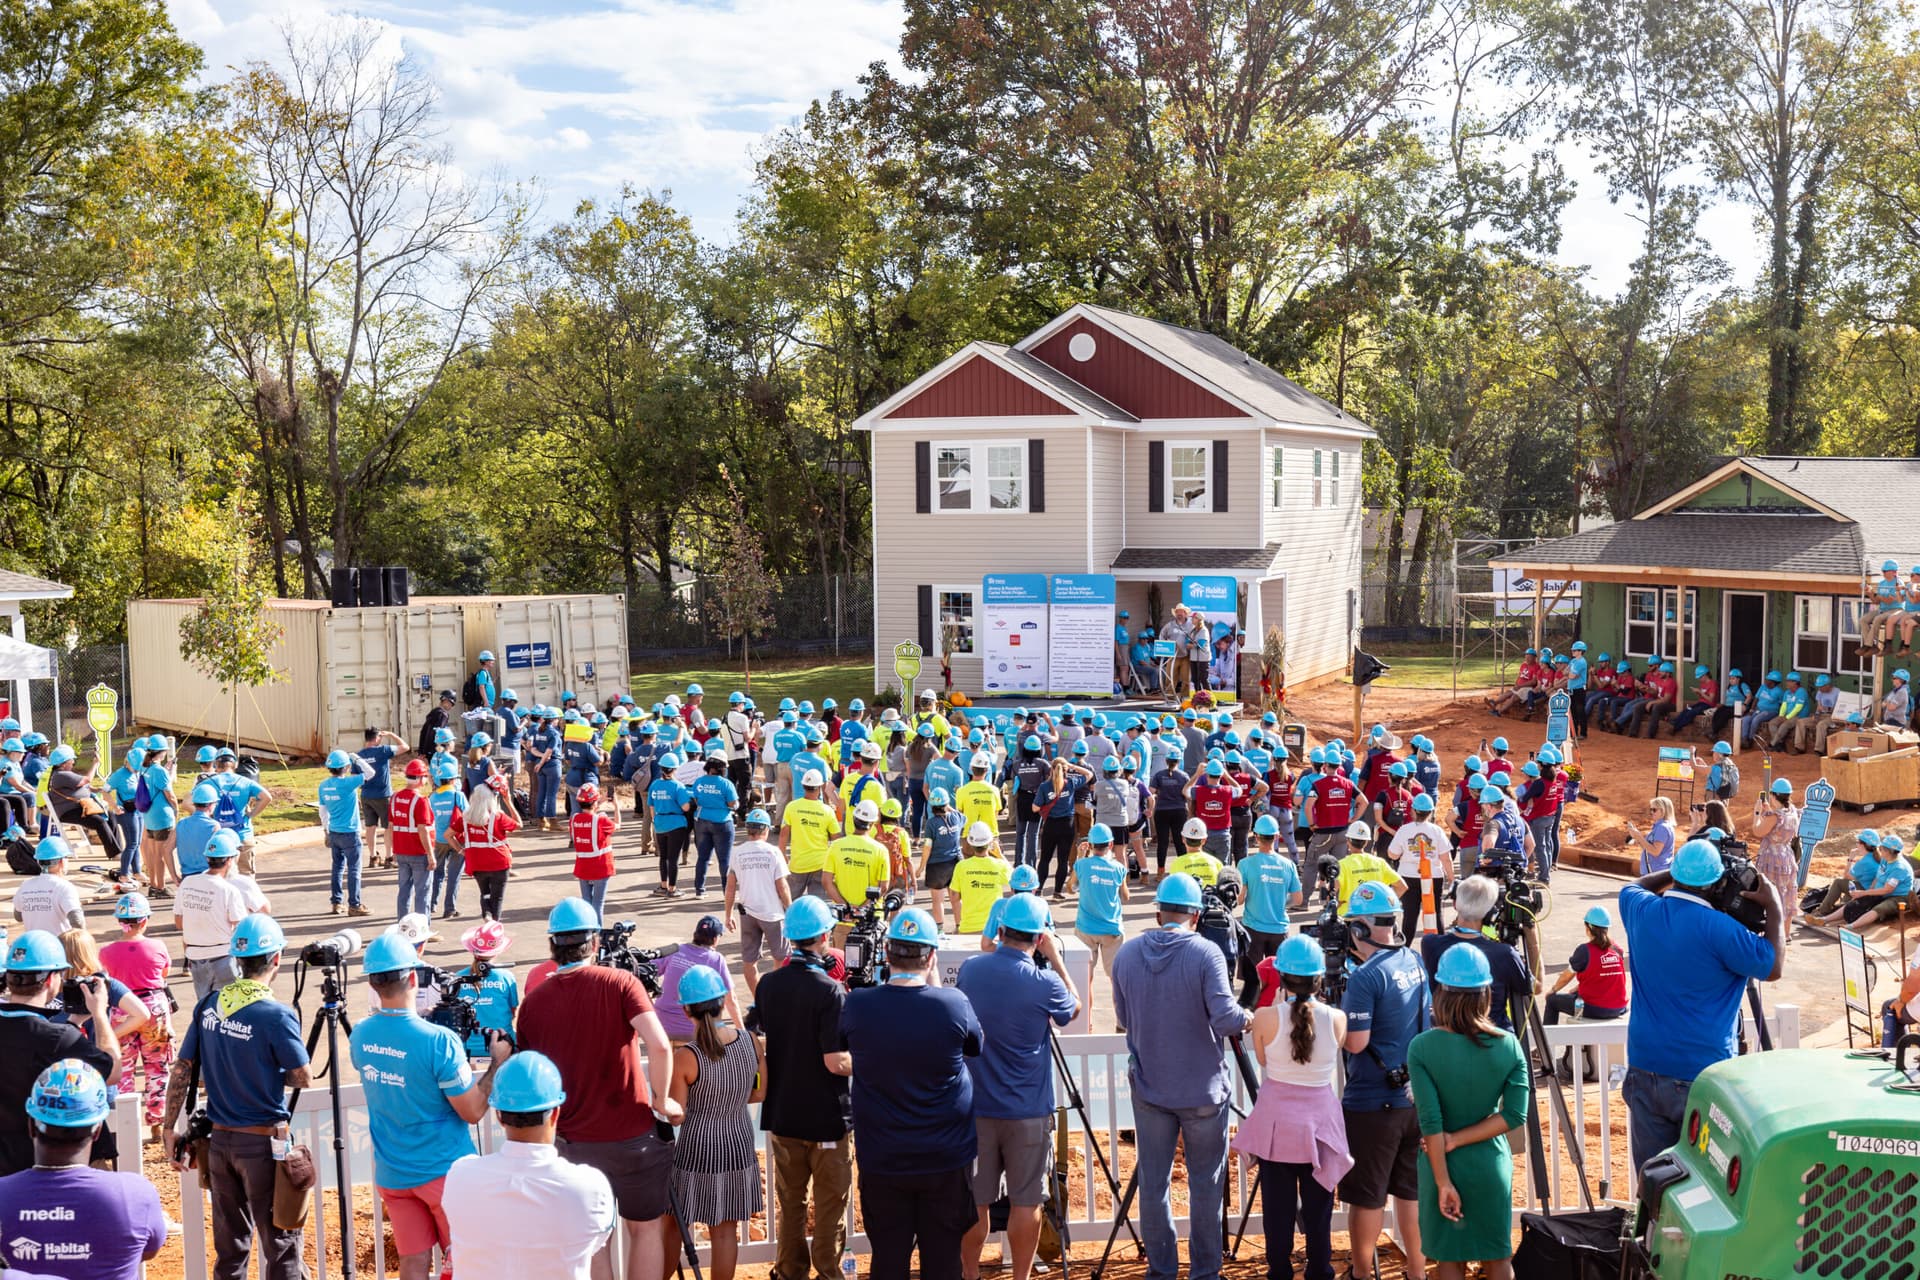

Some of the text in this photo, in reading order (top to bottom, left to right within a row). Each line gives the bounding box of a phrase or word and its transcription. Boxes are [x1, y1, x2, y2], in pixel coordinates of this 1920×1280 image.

[1542, 582, 1576, 591] Habiat
[947, 967, 961, 975] OU
[460, 980, 503, 990] oluteer
[220, 1018, 252, 1034] Habitat
[362, 1043, 407, 1059] volunteer
[380, 1071, 405, 1083] Habitat
[1840, 1136, 1918, 1156] 1040969
[19, 1206, 75, 1221] media
[44, 1243, 90, 1254] Habitat
